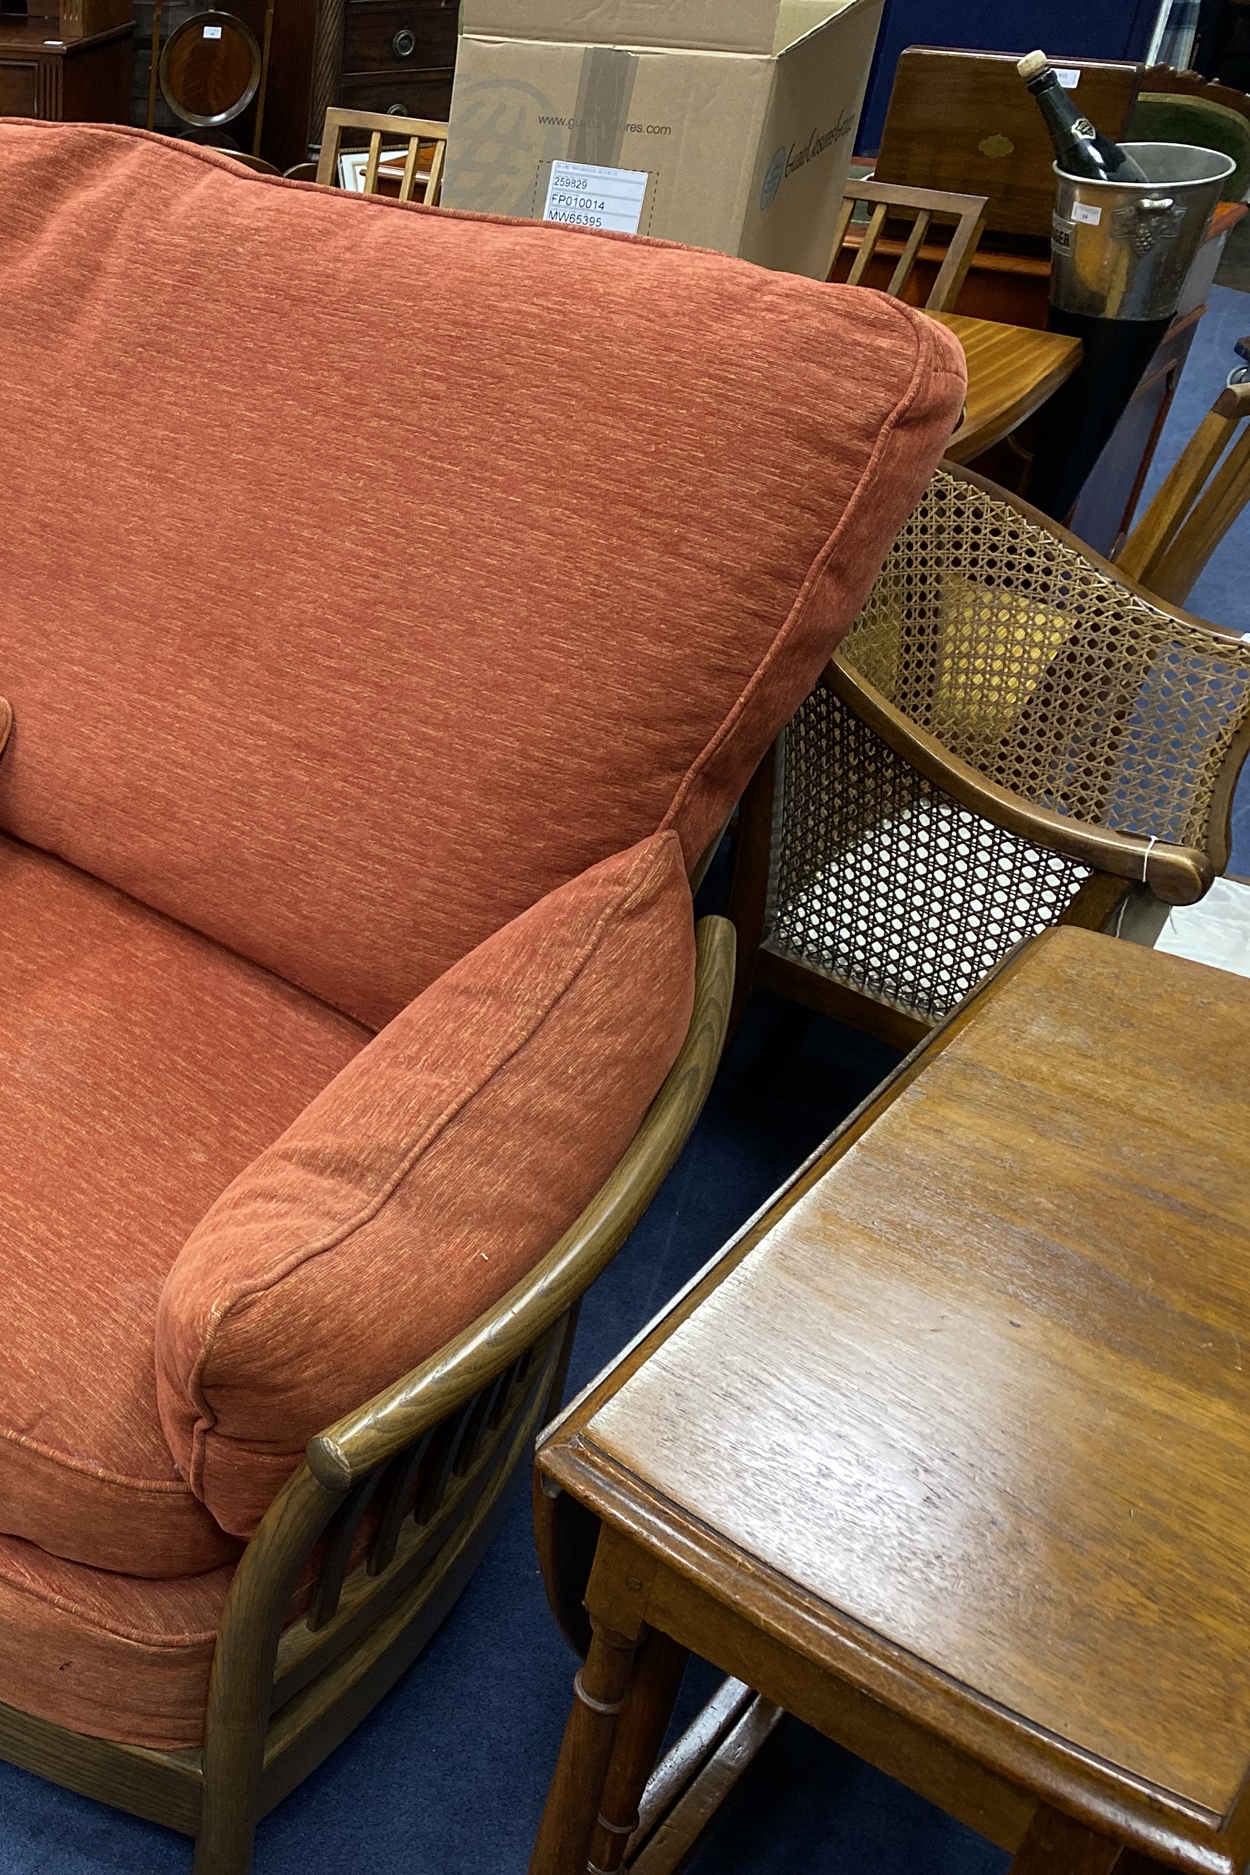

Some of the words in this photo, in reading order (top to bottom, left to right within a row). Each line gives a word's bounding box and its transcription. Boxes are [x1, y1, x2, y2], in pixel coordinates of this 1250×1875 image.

[554, 177, 588, 190] 259829
[551, 194, 605, 210] FP010014
[549, 211, 602, 227] MW65395
